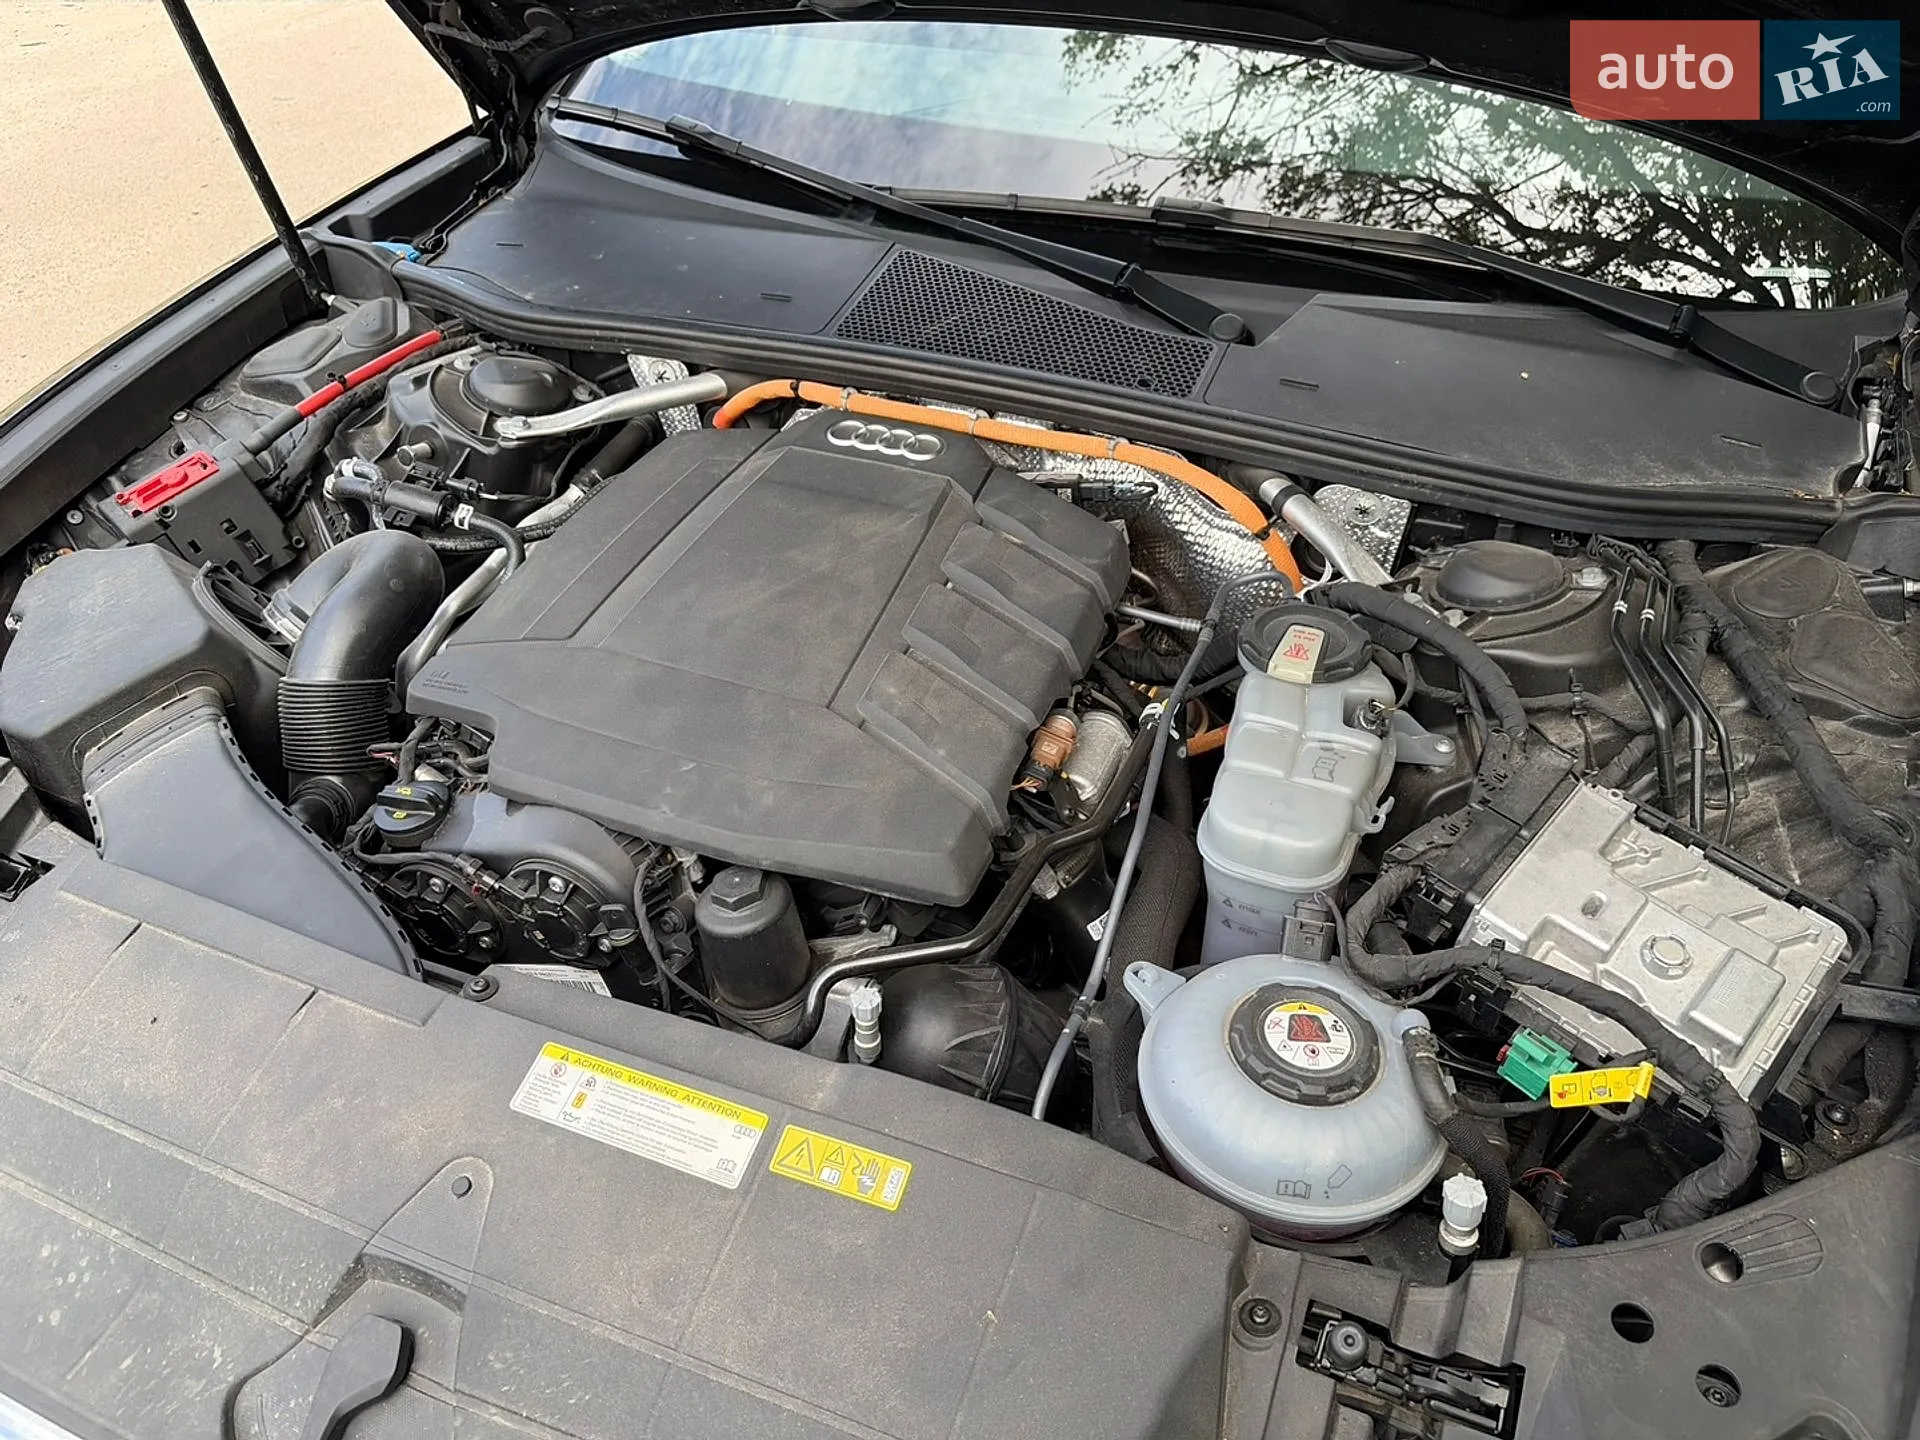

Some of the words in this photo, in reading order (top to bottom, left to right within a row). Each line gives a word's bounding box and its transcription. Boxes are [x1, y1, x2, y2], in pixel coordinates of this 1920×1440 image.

[573, 1057, 623, 1080] ACHTUNG
[627, 1074, 678, 1099] WARNING
[681, 1092, 742, 1120] ATTENTION
